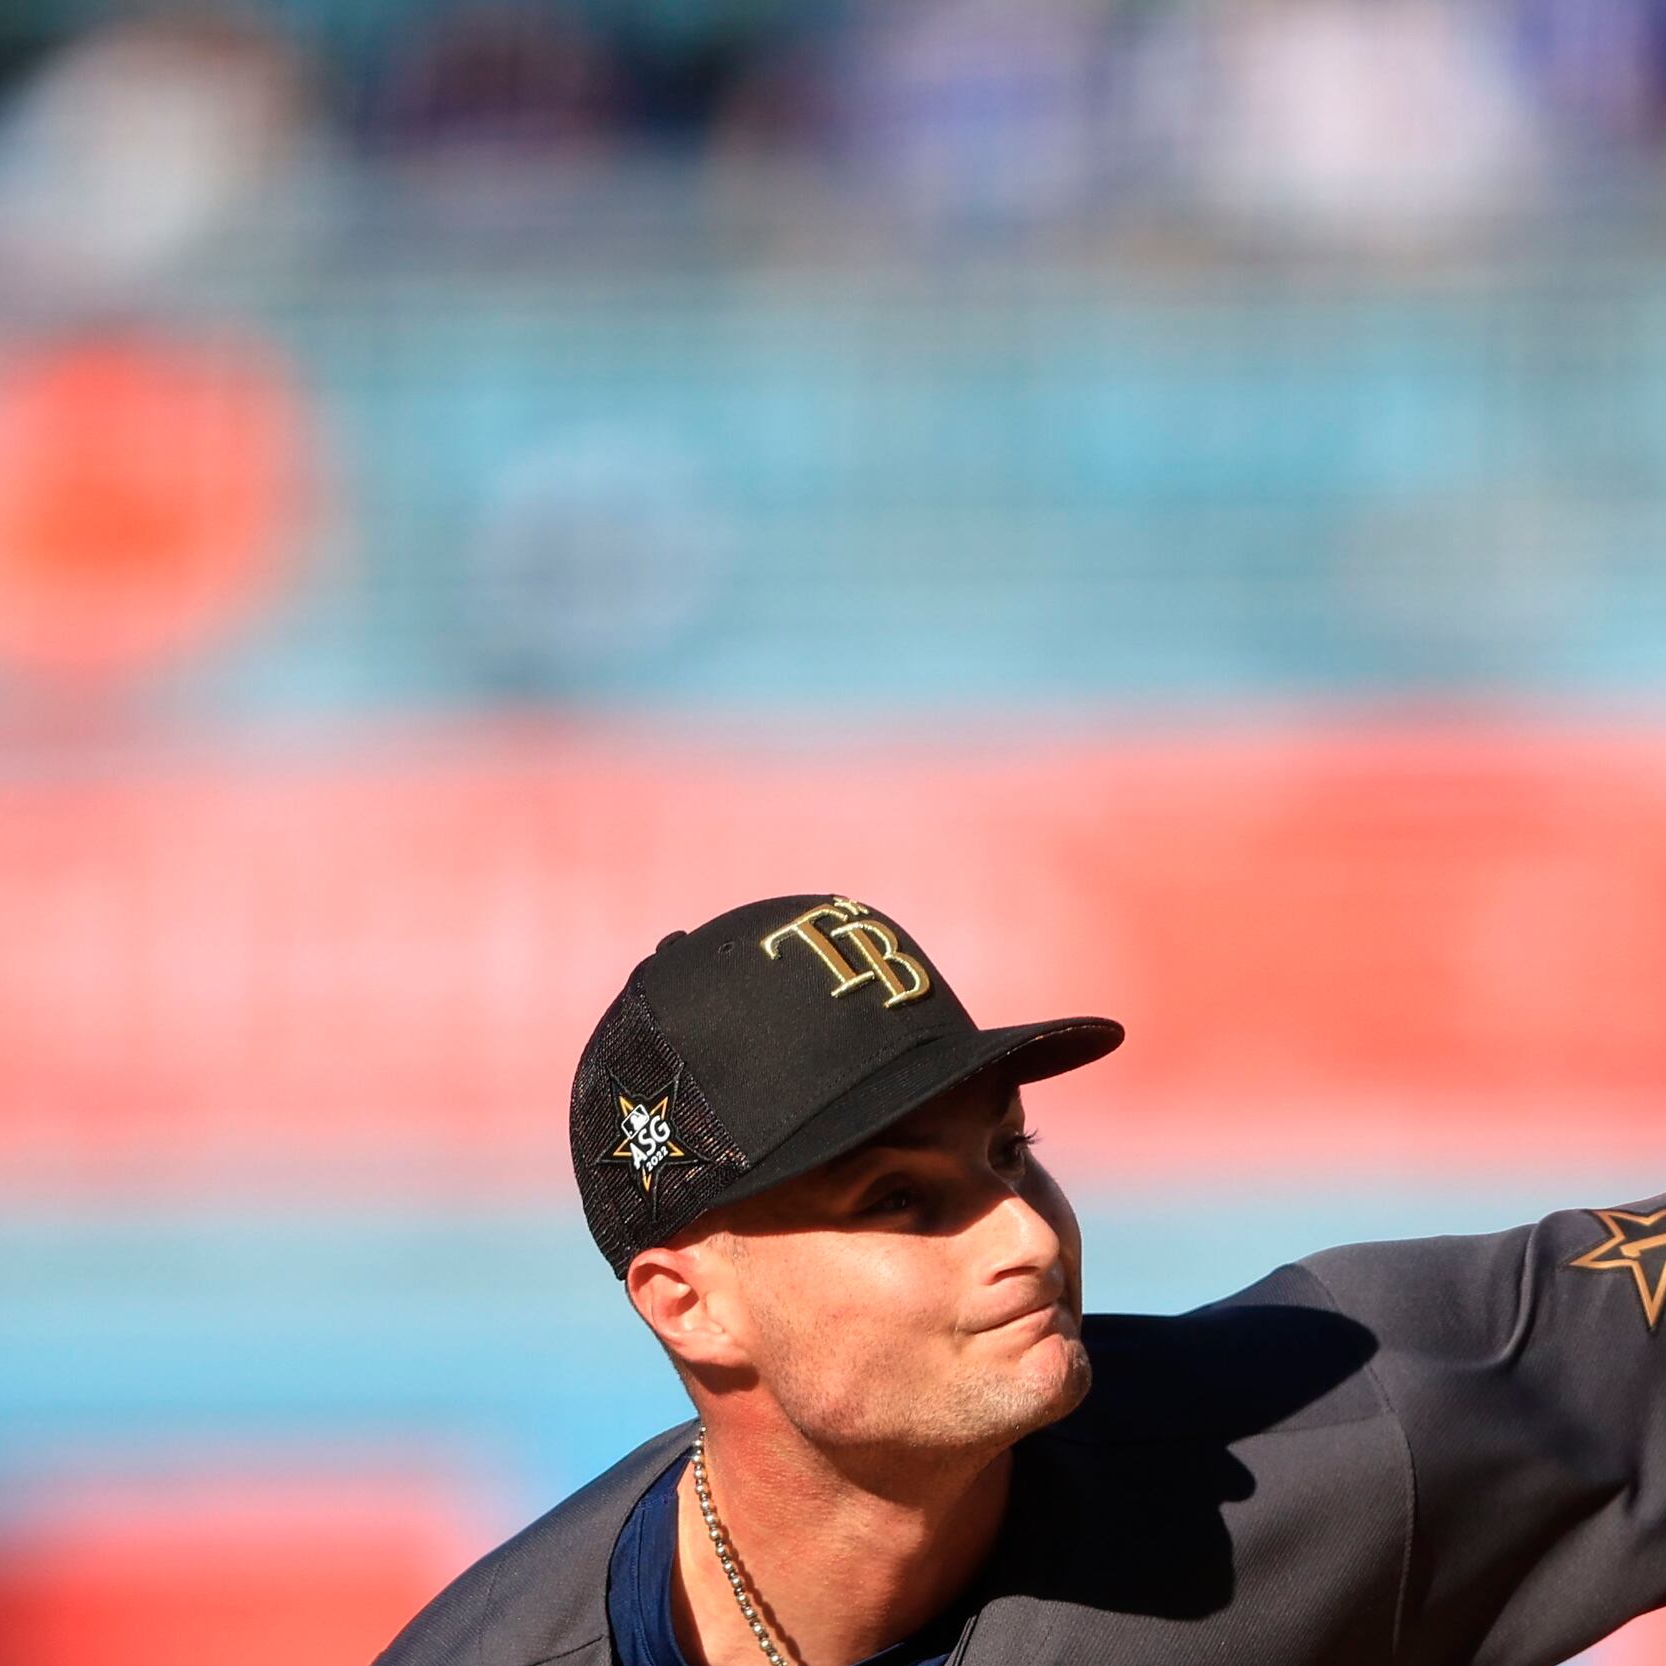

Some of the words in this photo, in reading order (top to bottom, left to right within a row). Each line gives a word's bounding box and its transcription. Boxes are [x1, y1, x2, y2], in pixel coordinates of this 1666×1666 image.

[760, 903, 930, 1009] TB
[629, 1115, 671, 1170] ASG
[646, 1145, 669, 1171] 2022
